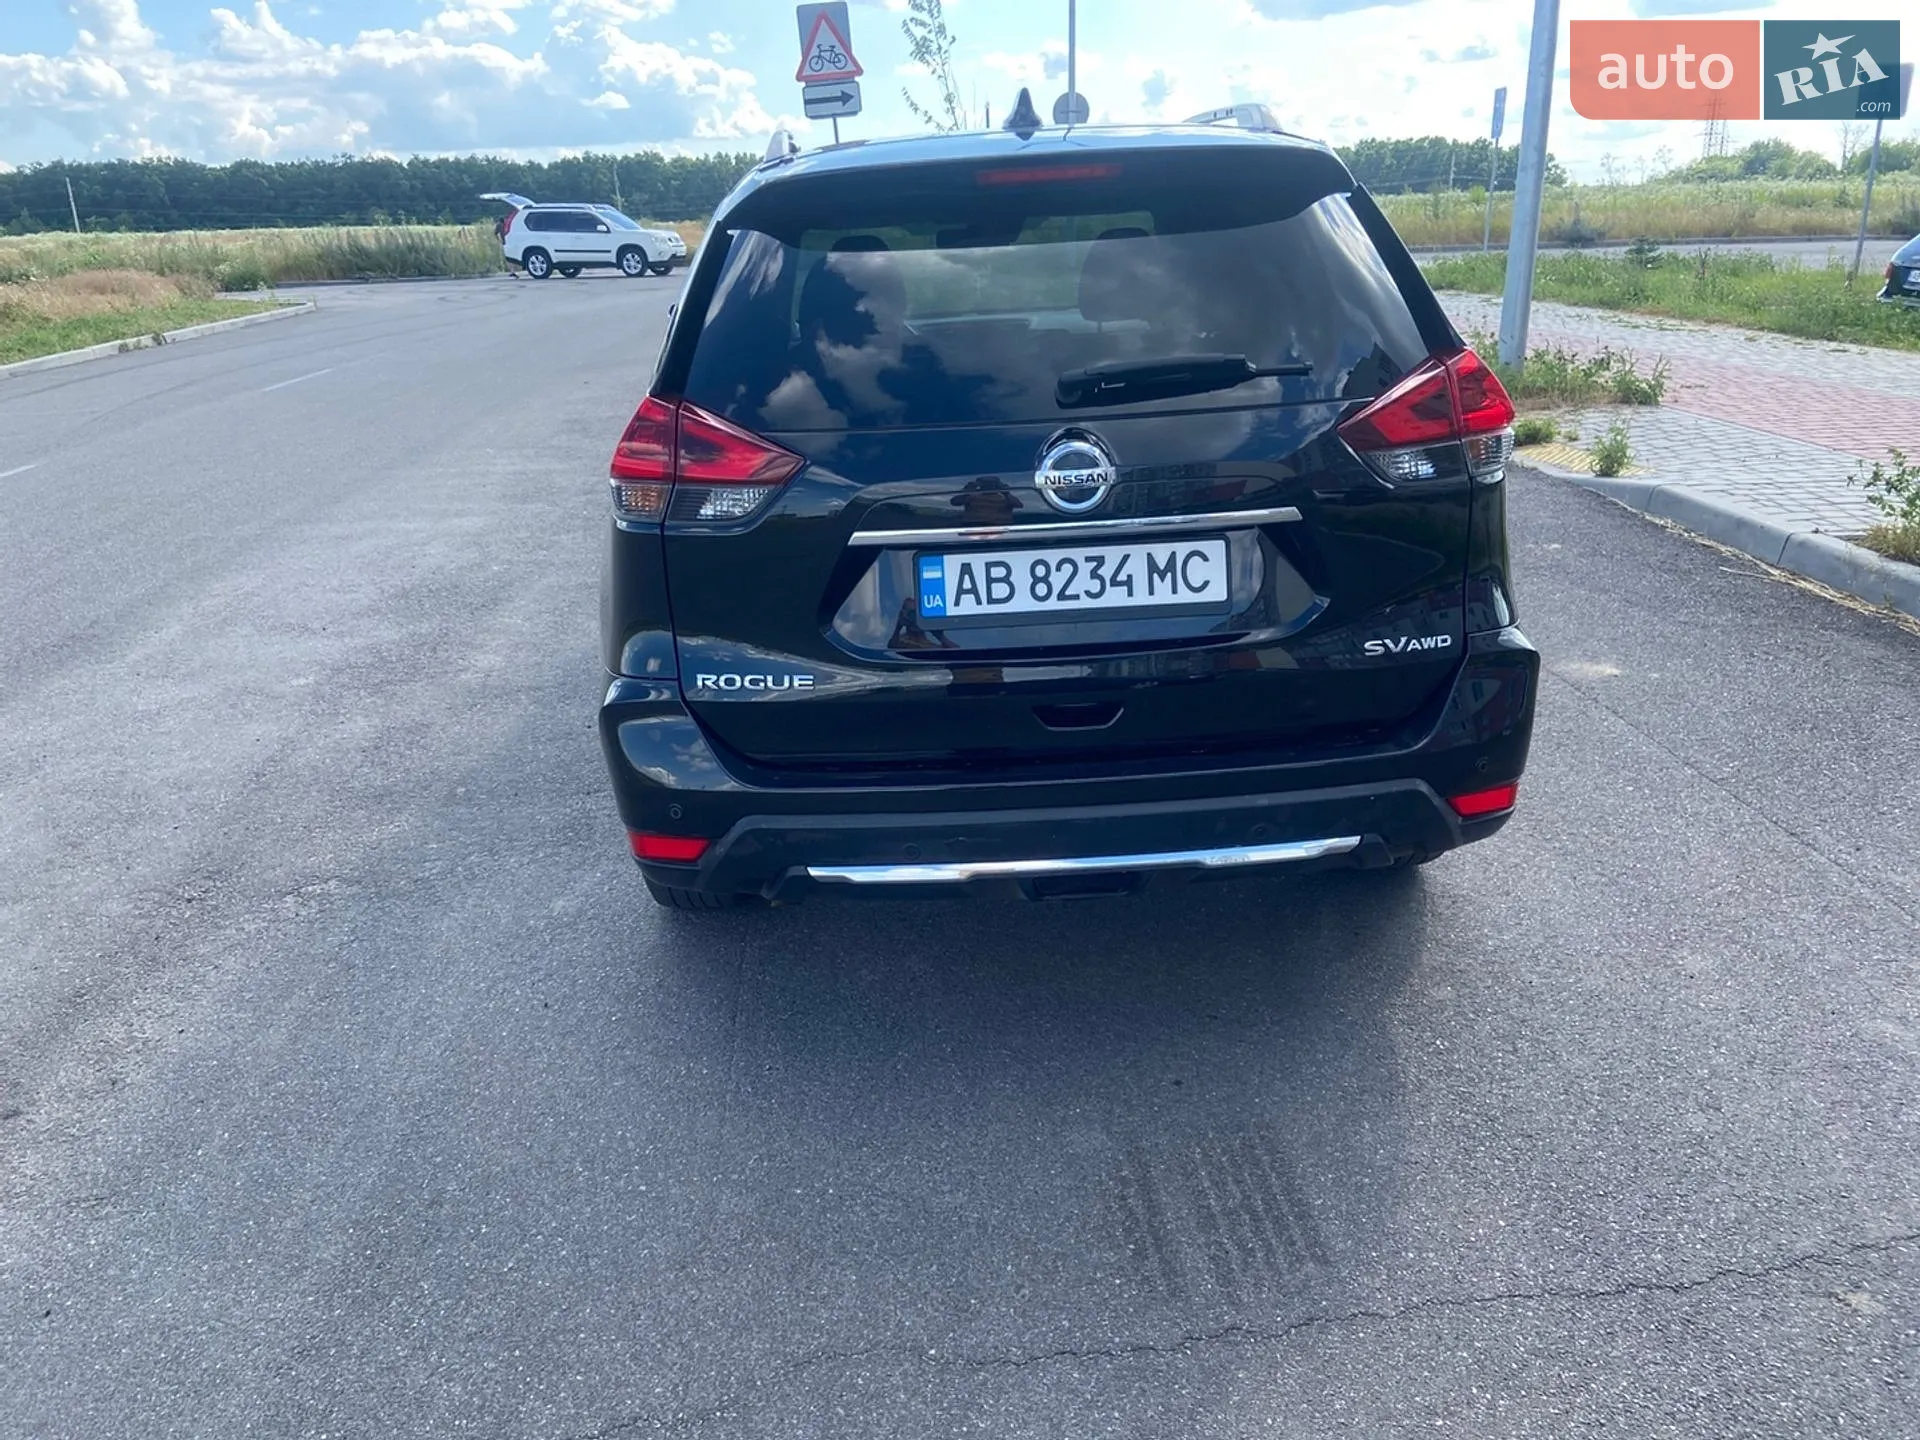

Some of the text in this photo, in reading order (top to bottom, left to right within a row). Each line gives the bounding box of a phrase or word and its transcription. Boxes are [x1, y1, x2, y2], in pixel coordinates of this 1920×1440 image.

[1044, 472, 1108, 485] NISSAN
[953, 550, 1210, 607] AB 8234 MC
[923, 595, 944, 609] UA
[696, 673, 815, 691] ROGUE
